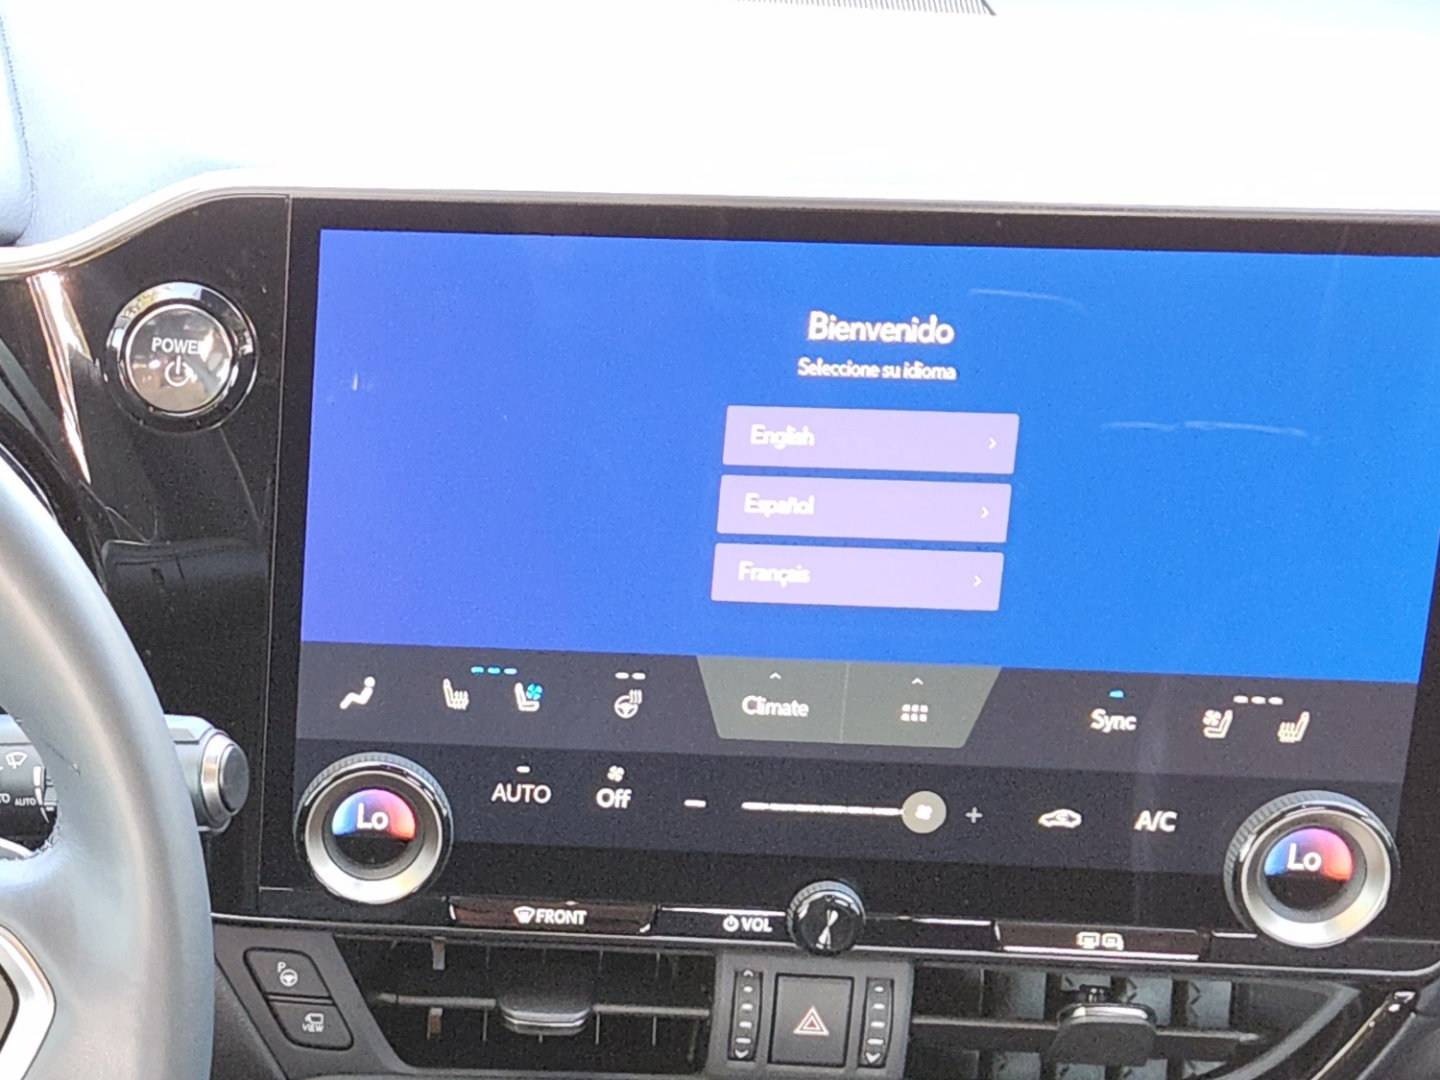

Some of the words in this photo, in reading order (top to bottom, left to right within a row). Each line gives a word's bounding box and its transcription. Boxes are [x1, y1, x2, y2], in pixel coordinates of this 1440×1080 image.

[807, 310, 956, 345] Bienvenido
[152, 336, 212, 354] POWE
[797, 356, 881, 379] Seleccione
[882, 365, 902, 379] su
[903, 360, 957, 380] idioma
[750, 424, 815, 450] English
[743, 492, 815, 518] Español
[737, 560, 811, 588] Français
[741, 695, 809, 717] Climate
[1090, 708, 1137, 733] Sync
[14, 797, 37, 806] AUTO
[491, 784, 552, 804] AUTO
[595, 788, 632, 809] Off
[355, 802, 389, 830] Lo
[1134, 811, 1178, 832] A/C
[1286, 843, 1322, 872] Lo
[535, 909, 587, 925] FRONT
[742, 917, 773, 933] VOL
[276, 961, 287, 973] P
[302, 1022, 325, 1033] VIEW
